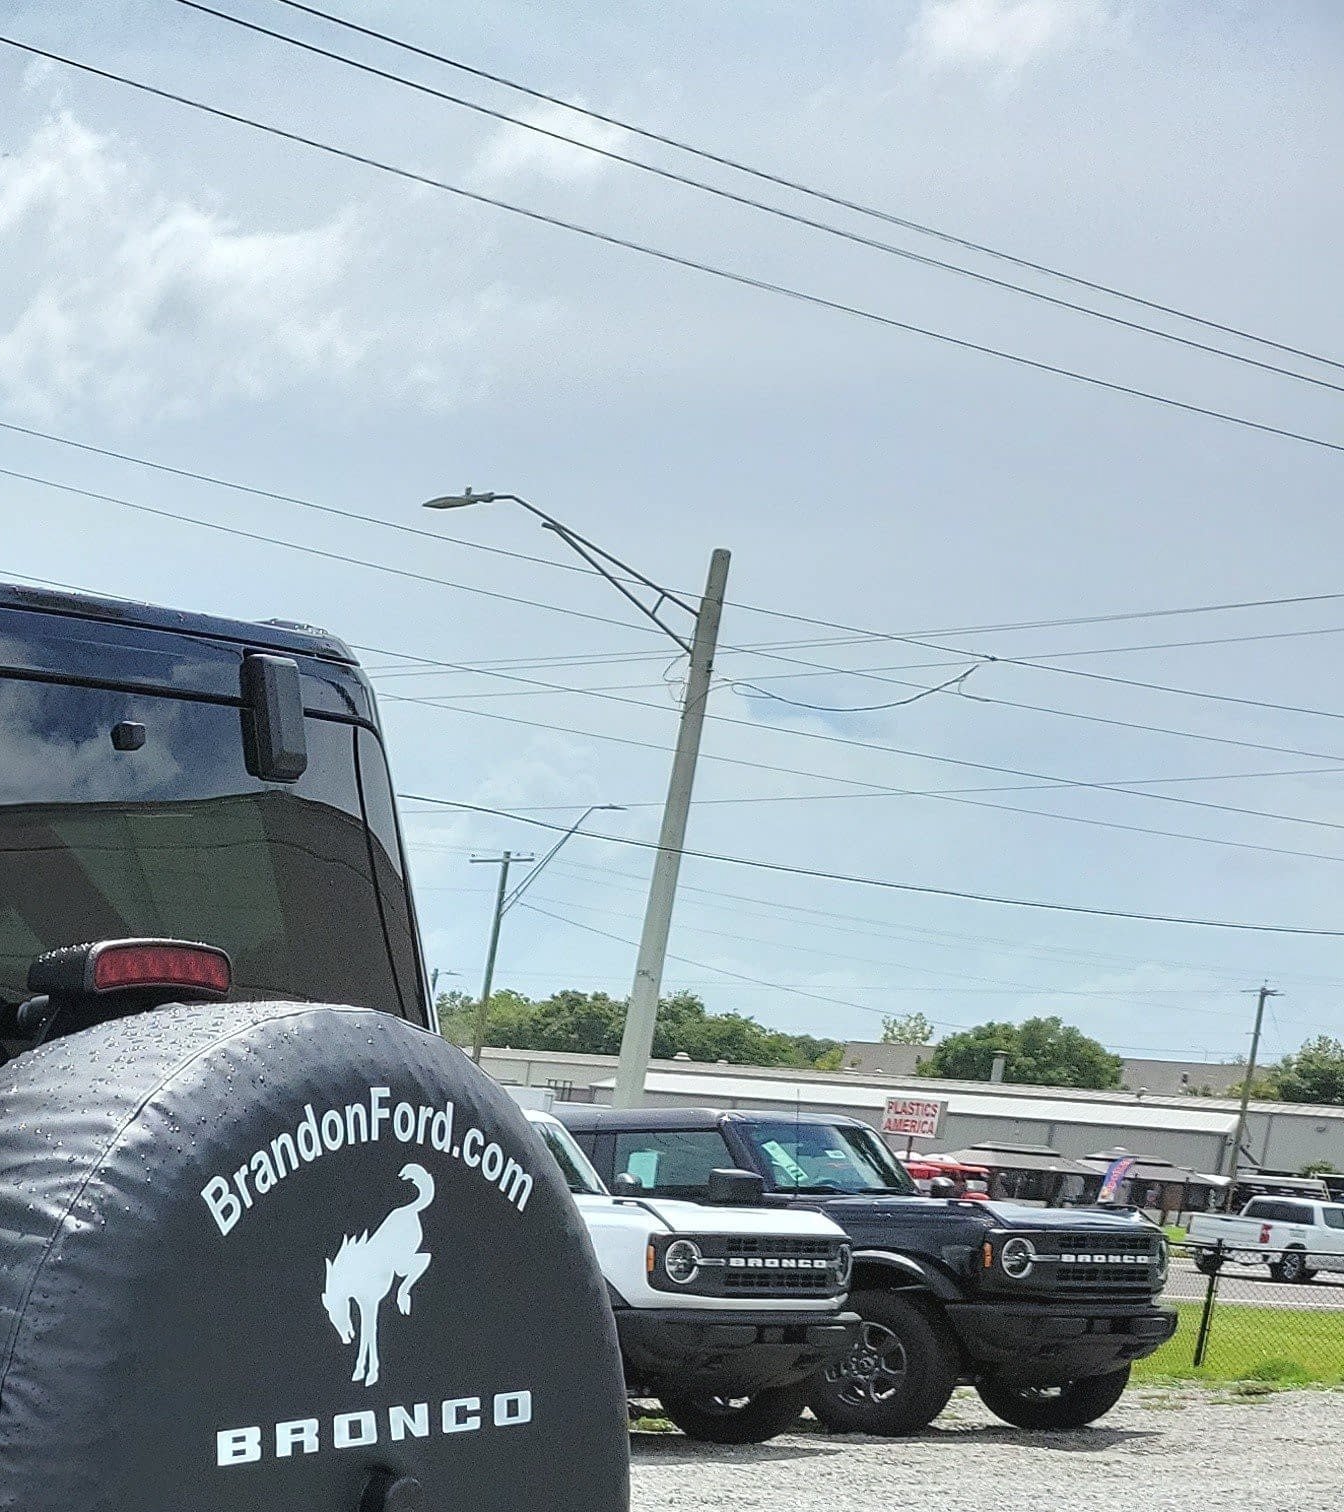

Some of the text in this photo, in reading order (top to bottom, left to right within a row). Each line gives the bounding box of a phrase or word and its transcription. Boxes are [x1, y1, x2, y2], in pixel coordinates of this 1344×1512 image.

[887, 1100, 938, 1118] PLASTICS
[883, 1118, 934, 1135] AMERICA
[200, 1086, 534, 1237] BrandonFord.com
[729, 1257, 827, 1269] BRONCO
[216, 1389, 532, 1467] BRONCO
